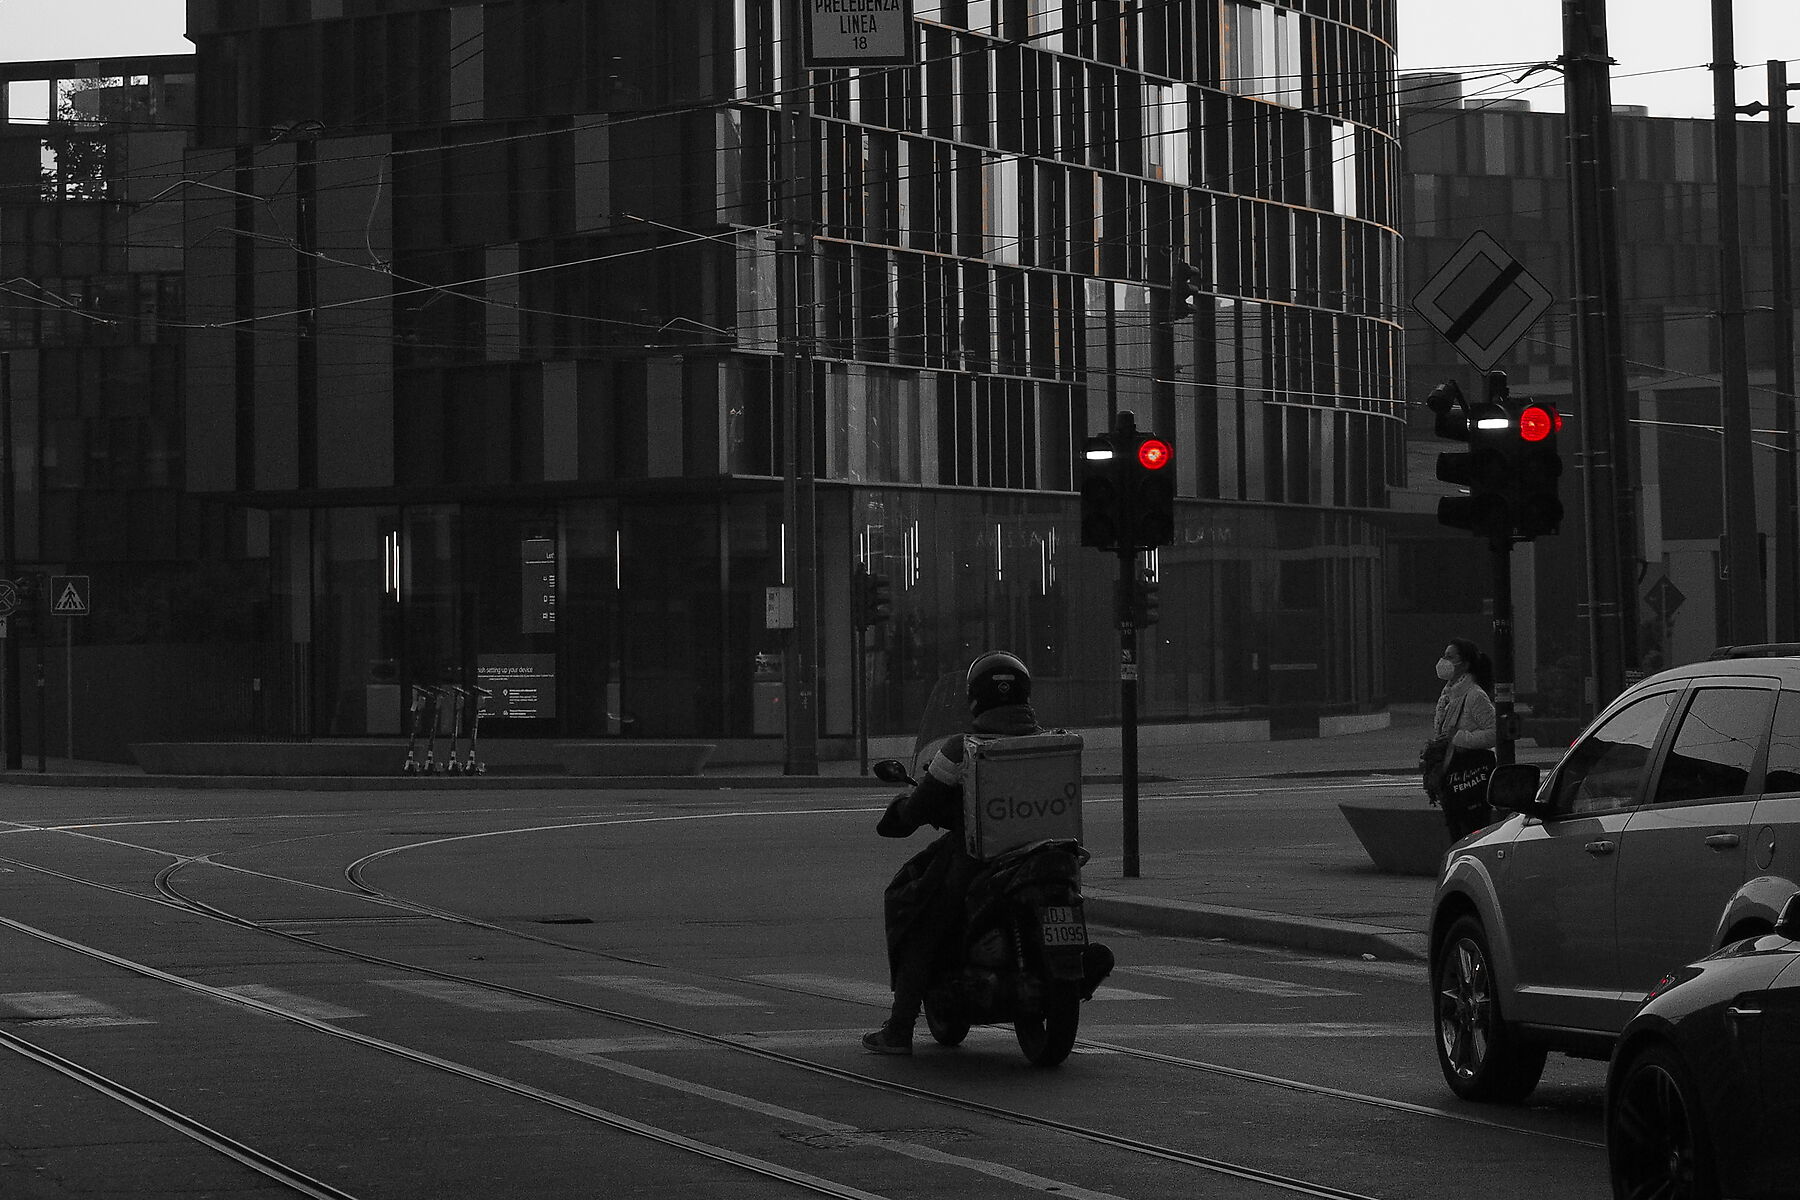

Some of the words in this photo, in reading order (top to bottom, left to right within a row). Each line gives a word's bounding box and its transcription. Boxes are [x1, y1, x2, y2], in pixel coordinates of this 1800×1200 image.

[840, 14, 877, 34] LINEA
[853, 36, 868, 50] 18
[1453, 773, 1487, 793] FEMALE
[986, 796, 1066, 820] Glovo
[1045, 926, 1083, 943] 51095
